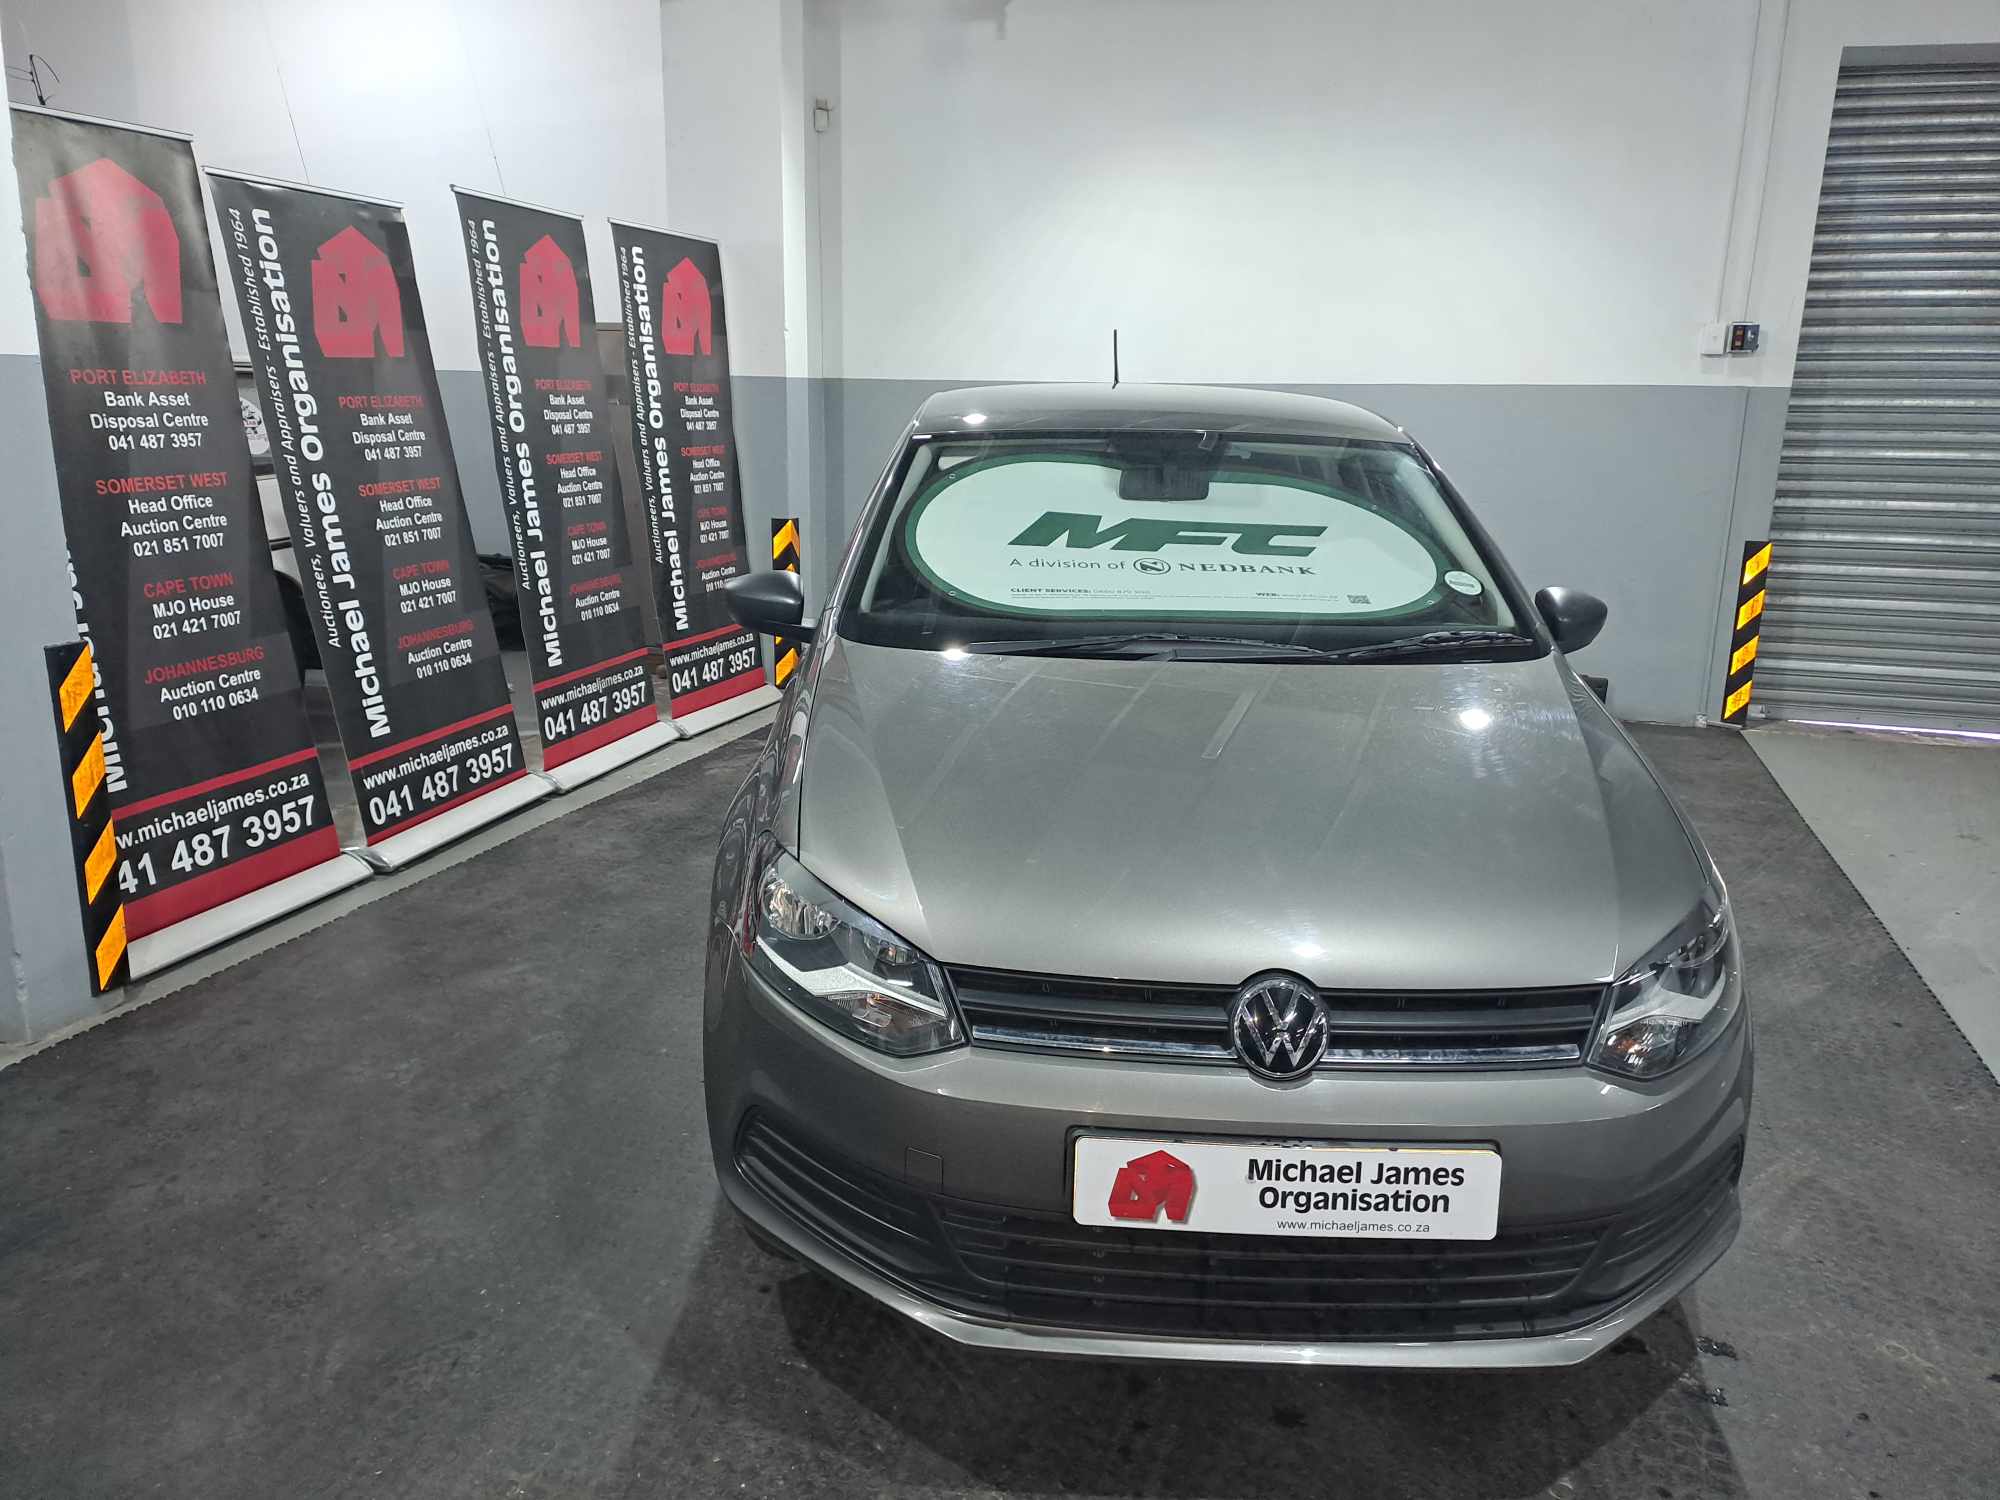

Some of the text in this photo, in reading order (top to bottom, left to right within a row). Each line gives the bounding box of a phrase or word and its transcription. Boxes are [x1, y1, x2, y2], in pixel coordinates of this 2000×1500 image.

[468, 219, 479, 254] 1964
[475, 257, 492, 339] Established
[623, 279, 637, 348] Established
[69, 369, 207, 384] PORT ELIZABETH
[487, 351, 505, 423] Appraisers
[631, 359, 647, 420] Appraisers
[103, 391, 191, 406] Bank Asset
[338, 396, 368, 408] PORT
[89, 412, 209, 432] Disposal Centre
[228, 207, 341, 648] Auctioneers, Valuers and Appraisers Established 1964
[360, 413, 413, 426] Bank Asset
[108, 433, 201, 450] 041 487 3957
[352, 430, 425, 446] Disposal Centre
[482, 219, 562, 668] Michael James Organisation
[497, 425, 509, 453] and
[631, 246, 689, 631] Michael James Organisation
[638, 422, 648, 446] and
[364, 446, 422, 461] 041 487 3957
[251, 208, 391, 738] Michael James Organisation
[503, 455, 517, 505] Valuers
[560, 466, 597, 479] Head Office
[642, 448, 654, 491] Valuers
[95, 472, 227, 495] SOMERSET WEST
[358, 477, 441, 497] SOMERSET WEST
[128, 494, 213, 514] Head Office
[379, 496, 432, 513] Head Office
[120, 513, 228, 537] Auction Centre
[376, 512, 443, 531] Auction Centre
[1008, 511, 1328, 557] MFC
[133, 533, 224, 557] 021 851 7007
[384, 527, 441, 547] 021 851 7007
[1009, 557, 1316, 575] A division of NEDBANK
[144, 572, 234, 598] CAPE TOWN
[399, 577, 452, 596] MJO House
[152, 594, 234, 618] MJO House
[400, 590, 457, 614] 021 421 7007
[153, 611, 241, 640] 021 421 7007
[407, 638, 472, 665] Auction Centre
[670, 633, 754, 667] www.michaeljames.co.za
[144, 646, 265, 685] JOHANNESBURG
[416, 653, 472, 679] 010 110 0634
[672, 646, 756, 693] 041 487 3957
[160, 669, 261, 703] Auction Centre
[541, 665, 644, 710] www.michaeljames.co.za
[173, 687, 259, 720] 010 110 0634
[544, 681, 646, 740] 041 487 3957
[363, 724, 509, 790] www.michaeljames.co.za
[369, 742, 513, 826] 041 487 3957
[116, 773, 310, 850] w.michaeljames.co.za
[118, 795, 314, 895] 41 487 3957
[1248, 1158, 1465, 1187] Michael James
[1259, 1187, 1450, 1214] Organisation
[1276, 1219, 1430, 1234] www.michaeljames.co.za
